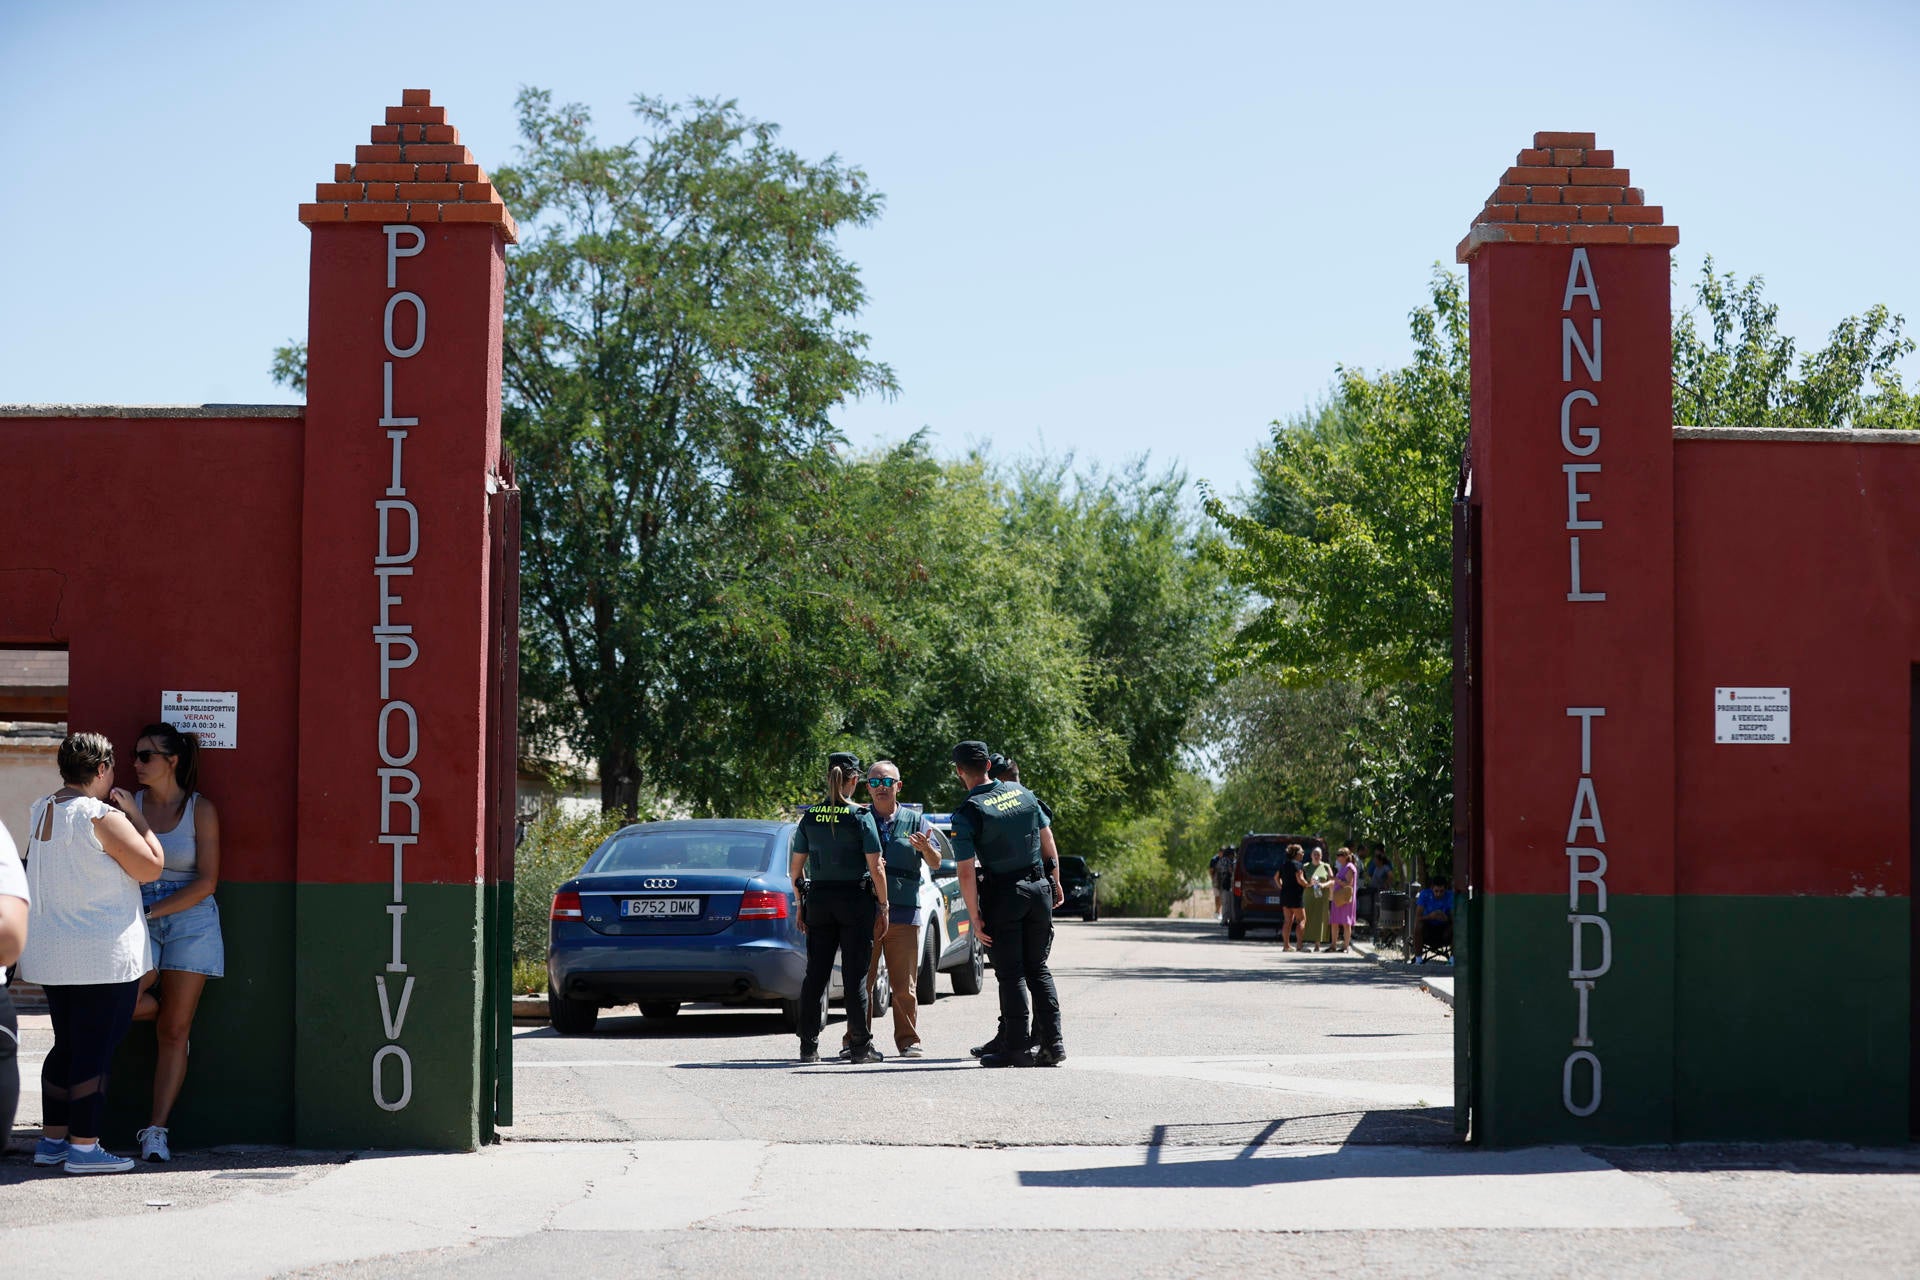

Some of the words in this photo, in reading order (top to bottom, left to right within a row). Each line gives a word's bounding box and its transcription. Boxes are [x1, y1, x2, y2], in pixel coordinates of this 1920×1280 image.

[1560, 247, 1606, 602] ANGEL
[372, 224, 426, 1112] POLIDEPORTIVO
[984, 789, 1023, 806] GUARDIA
[998, 798, 1021, 811] CIVIL
[816, 814, 840, 823] CIVL
[632, 901, 665, 913] 6752
[670, 901, 695, 913] DMK
[1562, 707, 1613, 1117] TARDIO
